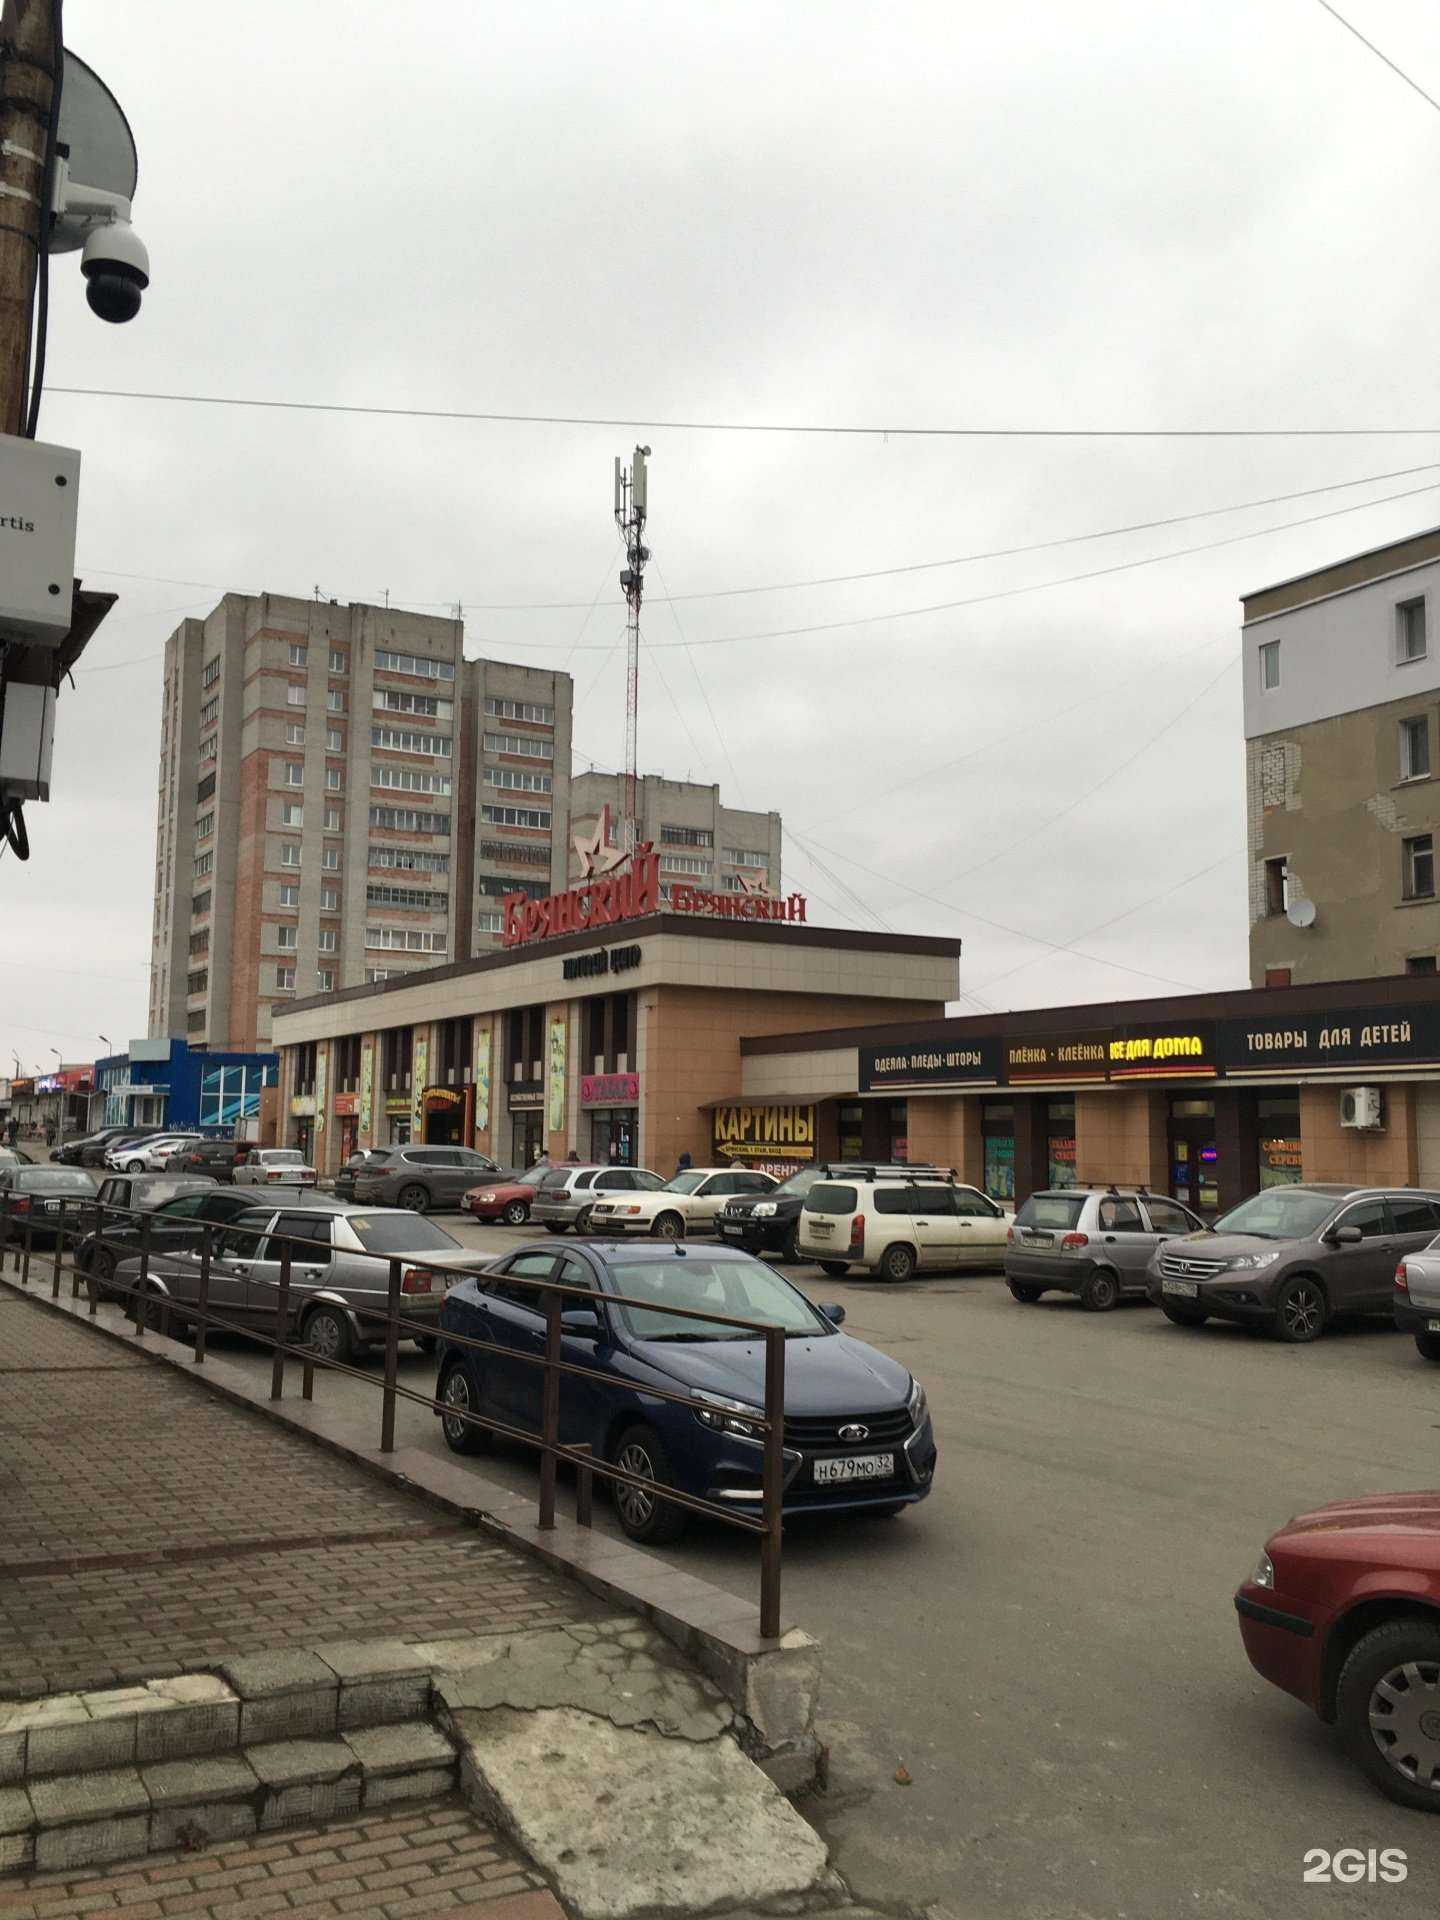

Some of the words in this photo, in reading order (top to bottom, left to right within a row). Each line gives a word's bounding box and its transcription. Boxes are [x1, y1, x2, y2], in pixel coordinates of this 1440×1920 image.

[1247, 1030, 1307, 1051] ТОВАРЫ
[1319, 1028, 1351, 1049] ДЛЯ
[1360, 1020, 1412, 1047] ДЕТЕЙ
[1009, 1045, 1047, 1065] ПЛЁНКА
[1126, 1038, 1151, 1061] ДЛЯ
[1153, 1036, 1202, 1060] ДОМА
[874, 1058, 907, 1073] ОДЕЯЛА
[911, 1054, 942, 1070] ПЛЕДЫ
[946, 1051, 982, 1067] ШТОРЫ
[714, 1105, 814, 1142] КАРТИНЫ
